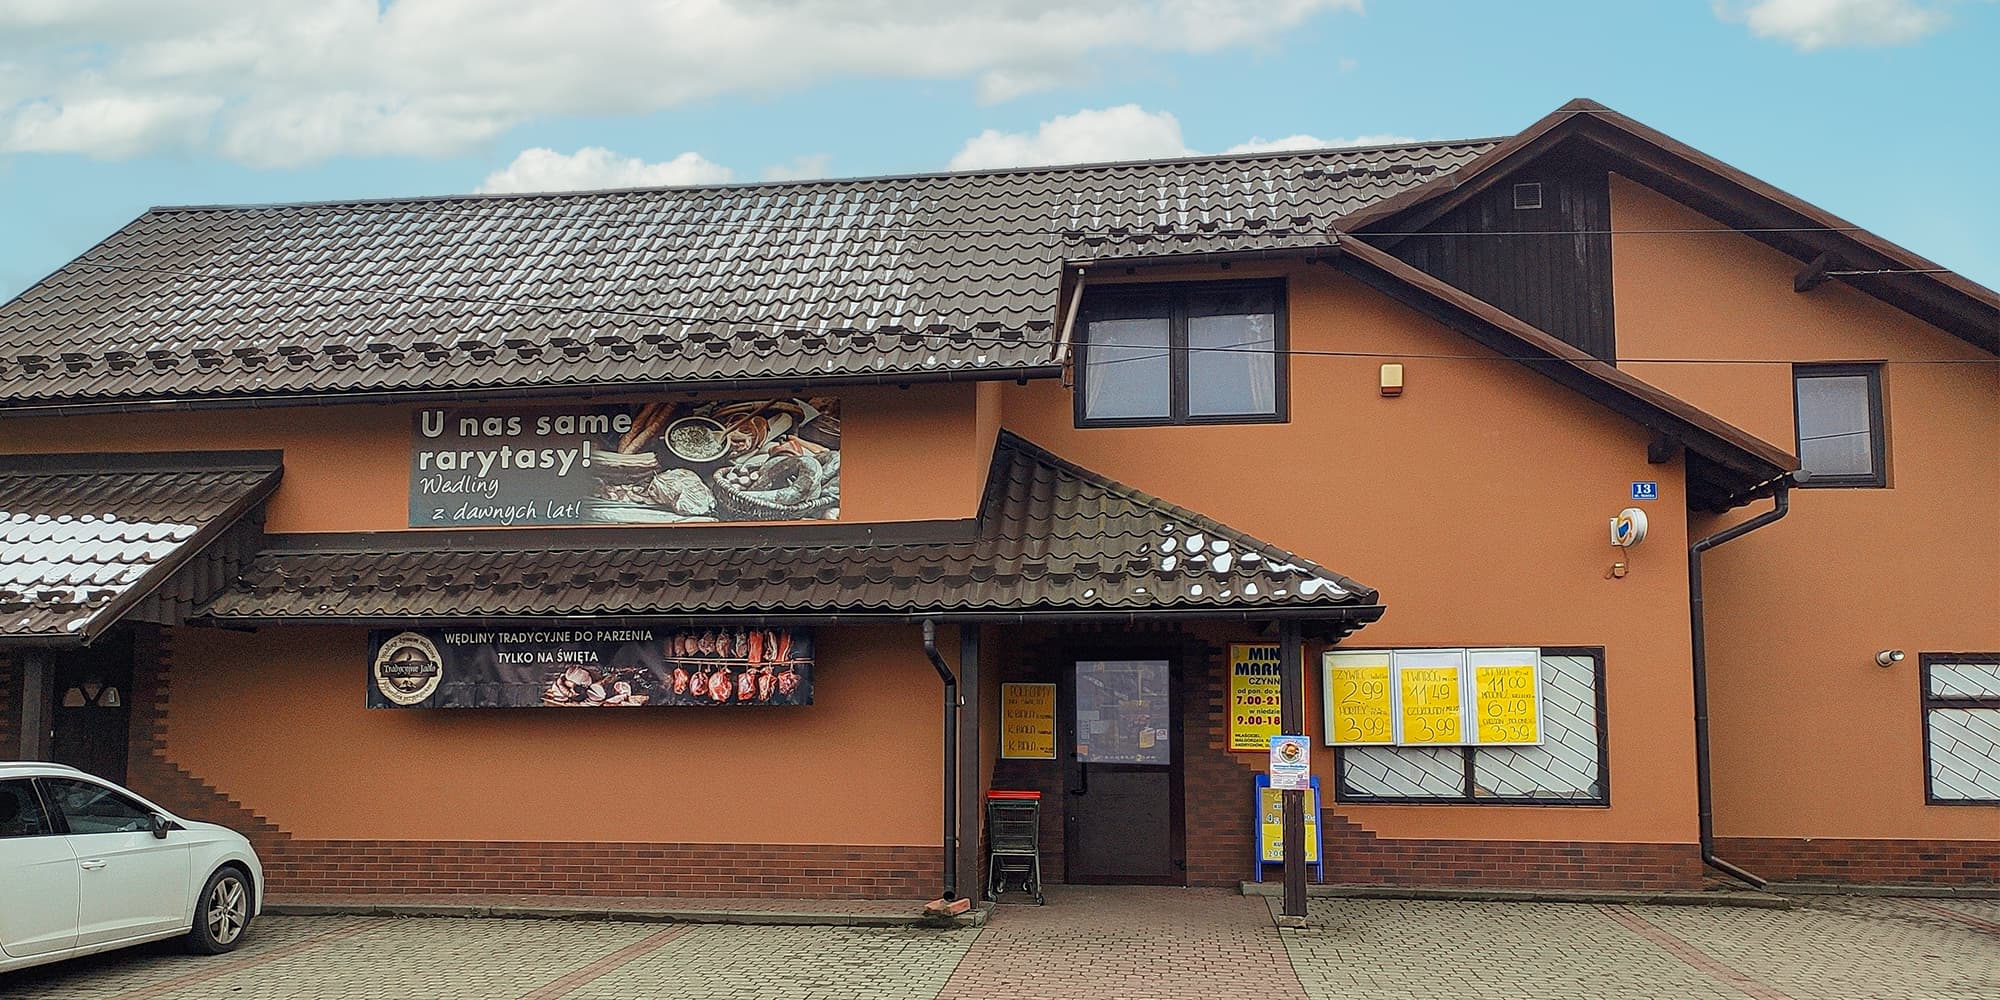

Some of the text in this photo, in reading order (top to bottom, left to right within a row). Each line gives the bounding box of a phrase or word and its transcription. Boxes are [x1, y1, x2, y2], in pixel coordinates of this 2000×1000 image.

[421, 411, 632, 438] U nas same
[419, 441, 591, 477] rarytasy!
[1636, 483, 1651, 494] 13
[432, 500, 581, 526] z dawnych lat!
[444, 630, 653, 647] WĘDLINY TRADYCYJNE DO PARZENIA
[497, 648, 599, 664] TYLKO NA ŚWIĘTA
[1249, 647, 1281, 661] MIN
[1235, 662, 1281, 676] MARK
[1249, 677, 1281, 685] CZYNN
[1236, 695, 1280, 705] 7.00-21
[1237, 715, 1281, 725] 9.00-18
